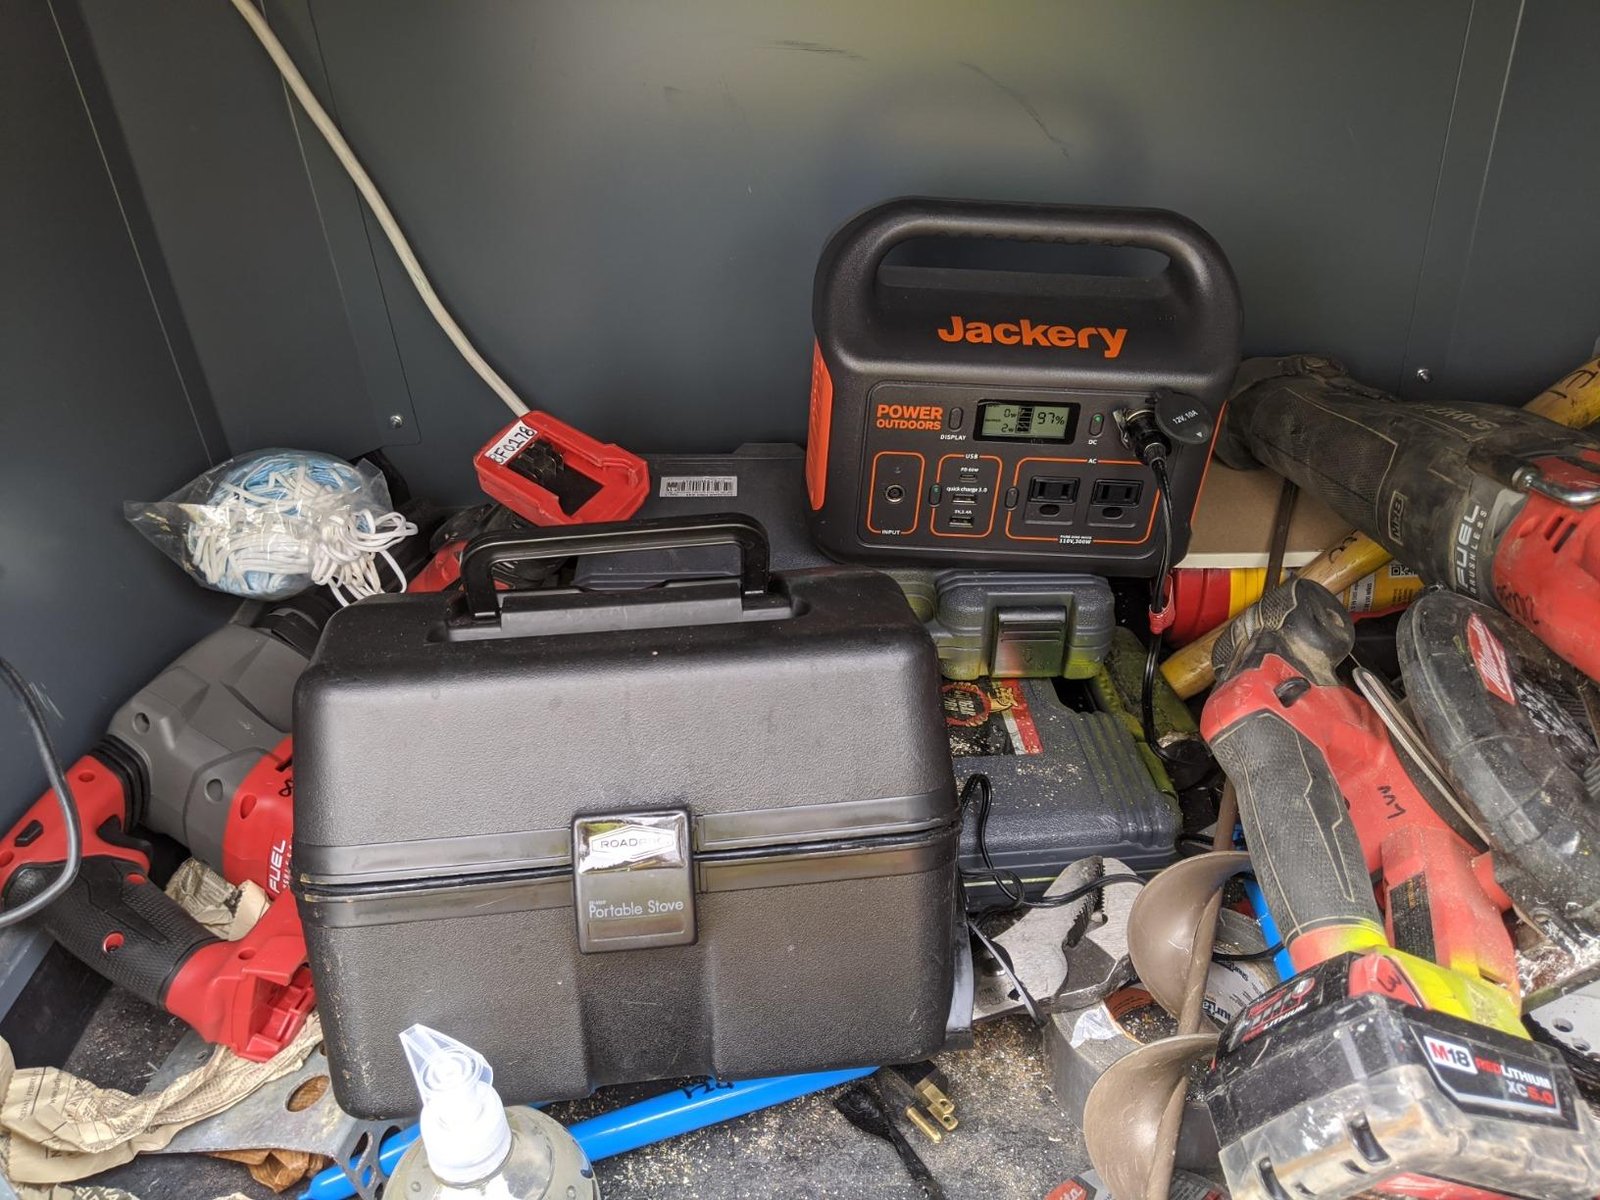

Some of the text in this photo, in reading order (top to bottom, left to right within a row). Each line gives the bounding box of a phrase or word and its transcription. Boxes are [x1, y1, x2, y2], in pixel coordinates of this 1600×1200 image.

[937, 316, 1128, 359] Jackery
[876, 404, 943, 420] POWER
[1037, 411, 1065, 426] 97%
[876, 419, 942, 431] OUTDOORS
[940, 433, 967, 441] DISPLAY
[1088, 438, 1098, 446] DC
[1087, 457, 1098, 465] AC
[1457, 505, 1480, 588] FUEL
[269, 839, 286, 893] FUEL
[588, 900, 684, 919] Portable Stove
[1429, 1042, 1471, 1068] M18
